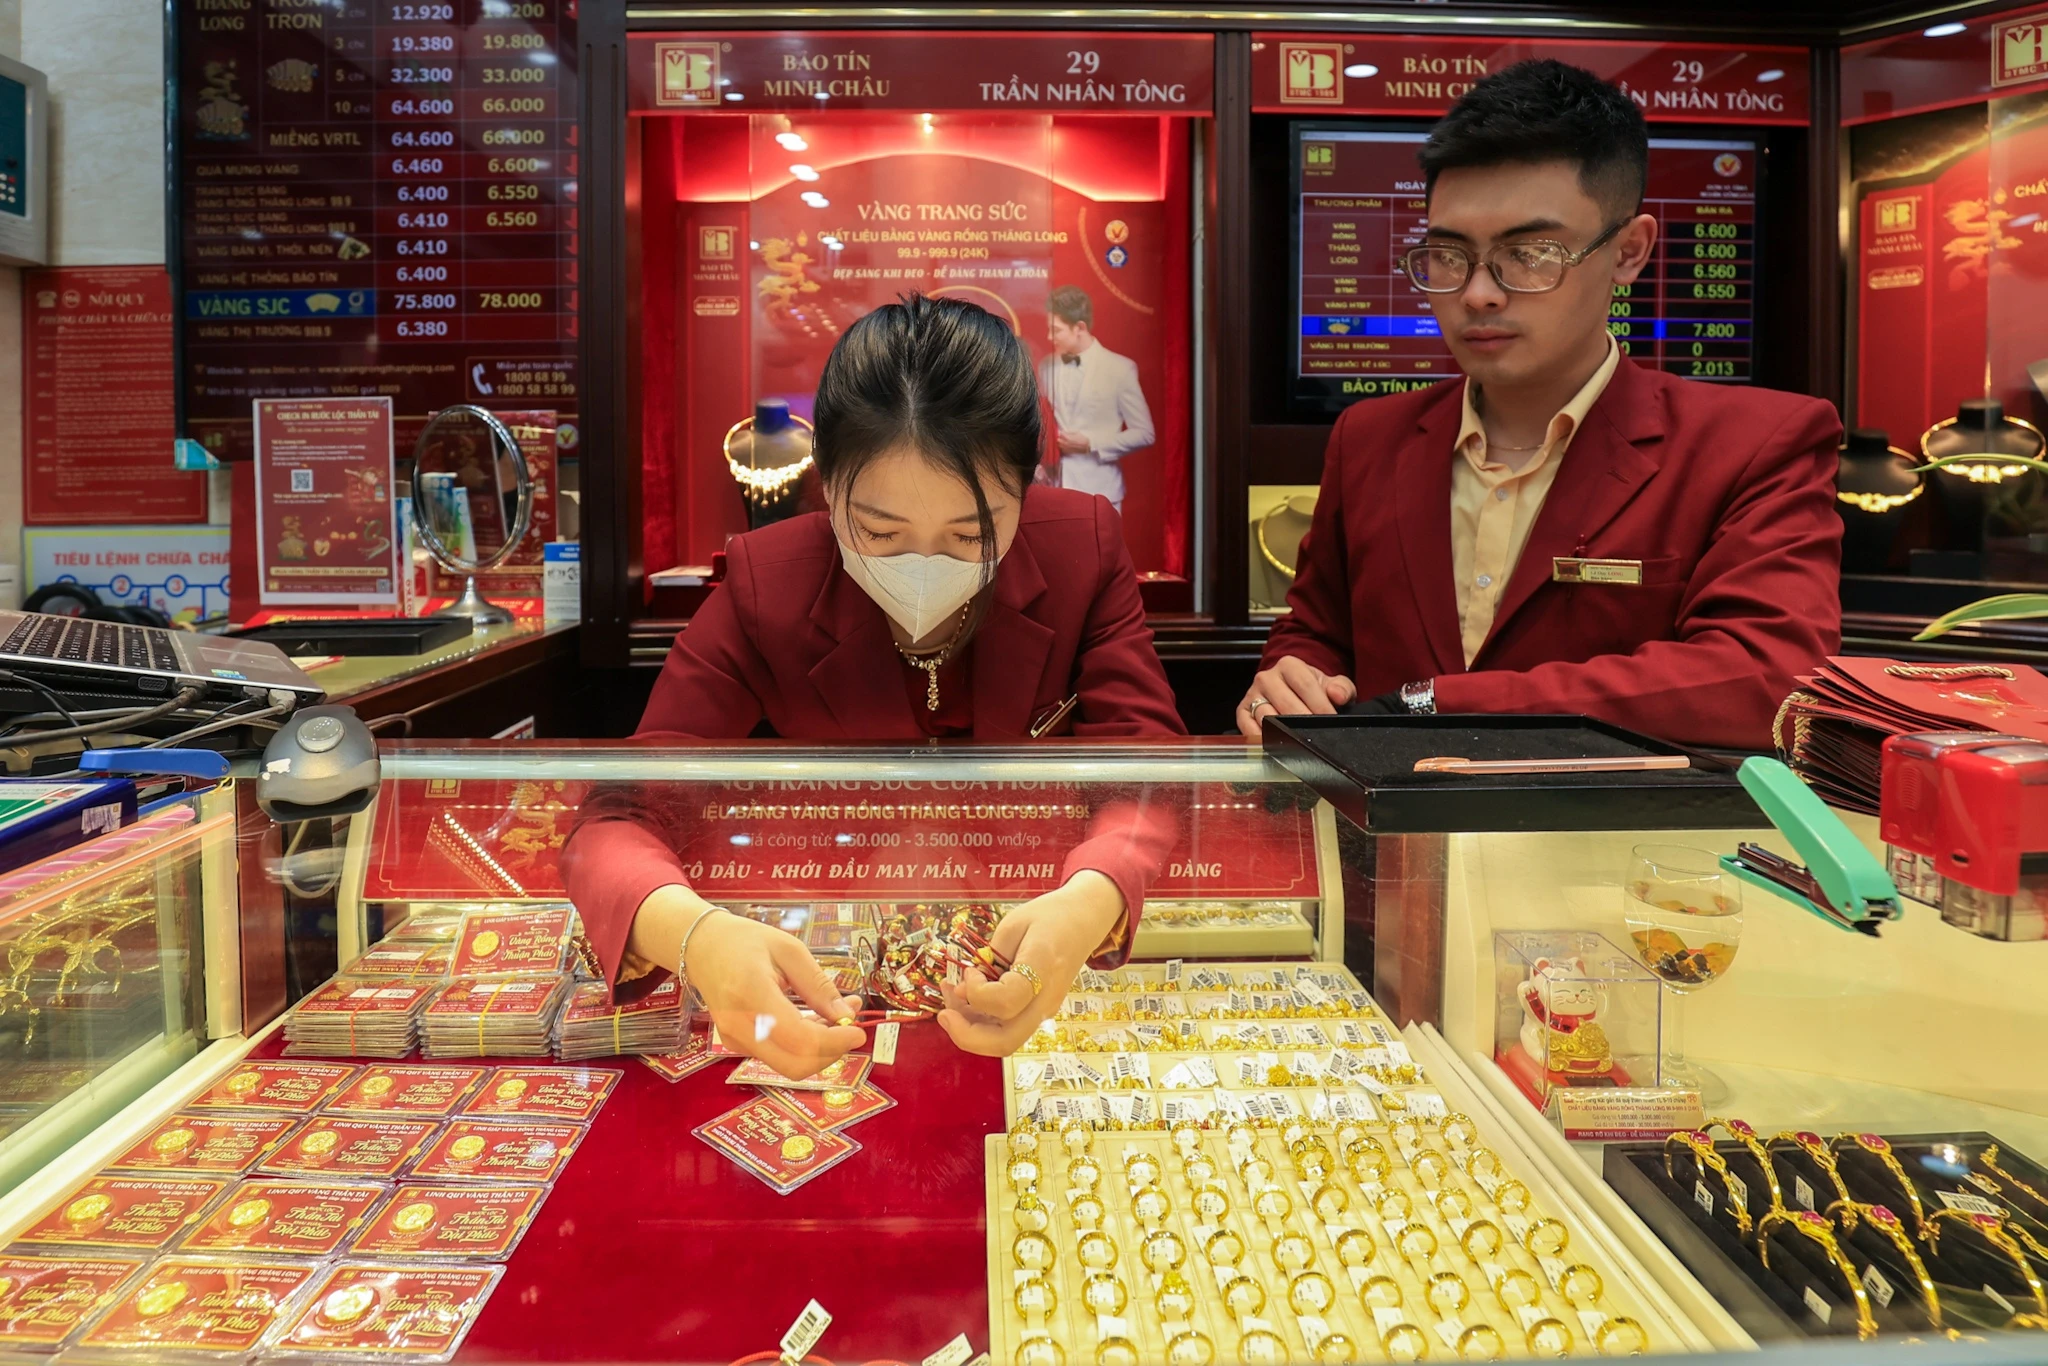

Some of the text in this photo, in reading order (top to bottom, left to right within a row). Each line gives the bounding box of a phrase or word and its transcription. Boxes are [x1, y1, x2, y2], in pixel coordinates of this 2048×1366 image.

[201, 16, 245, 31] LONG
[336, 7, 344, 18] 2
[392, 4, 544, 20] 12.920 1.200
[335, 34, 544, 52] 3 19.380 19.800
[783, 50, 871, 71] BẢO TÍN
[1066, 51, 1100, 74] 29
[1403, 53, 1488, 75] BẢO TÍN
[335, 67, 545, 83] 5 32.300 33.000
[1672, 60, 1704, 83] 29
[2005, 65, 2037, 78] BTMC
[764, 76, 890, 97] MINH CHÂU
[978, 74, 1186, 102] TRẦN NHÂN TÔNG
[1385, 81, 1476, 98] MINH CH
[334, 98, 545, 115] 10 64.600 66.000
[1654, 86, 1718, 109] NHÂN
[1725, 88, 1784, 112] TÔNG
[323, 132, 361, 146] VRTL
[391, 130, 453, 147] 64.600
[482, 129, 545, 145] 66.000
[391, 157, 538, 174] 6.460 6.600
[397, 184, 538, 201] 6.400 6.550
[2013, 178, 2048, 198] CHẤ
[858, 200, 1028, 221] VÀNG TRANG SỨC
[397, 211, 538, 228] 6.410 6.560
[852, 228, 878, 244] LIỆU
[881, 229, 915, 243] BẰNG
[918, 229, 952, 243] VÀNG
[992, 229, 1032, 243] THĂNG
[1035, 231, 1068, 244] LONG
[1694, 223, 1737, 239] 6.600
[396, 240, 448, 256] 6.410
[897, 247, 989, 260] 99.9 999.9 (24K)
[1694, 243, 1737, 259] 6.600
[1330, 255, 1358, 265] LONG
[396, 266, 447, 282] 6.400
[855, 268, 880, 279] SANG
[882, 268, 901, 279] KHI
[979, 268, 1013, 279] THANH
[1693, 263, 1737, 279] 6.560
[1693, 283, 1736, 299] 6.550
[198, 293, 542, 316] VÀNG SJC 75.800 78.000
[396, 321, 448, 337] 6.380
[1693, 323, 1735, 338] 7.800
[1692, 342, 1703, 357] 0
[1692, 361, 1734, 376] 2.013
[505, 372, 531, 382] 1800
[496, 384, 575, 395] 1800 58 58 99
[1342, 378, 1407, 393] BẢO TÍN
[116, 578, 182, 591] 2 3
[702, 799, 1090, 822] IỆU BẰNG VÀNG RỒNG THĂNG LONG 99.9 999
[768, 832, 808, 850] công
[811, 832, 832, 847] từ:
[914, 832, 993, 847] 3.500.000
[997, 832, 1041, 850] vnđ/sp
[709, 861, 751, 879] DÂU
[771, 859, 823, 879] KHỞI
[828, 857, 869, 879] ĐẦU
[875, 863, 918, 879] MAY
[922, 857, 967, 879] MẮN
[988, 863, 1055, 879] THANH
[1169, 859, 1222, 879] DÀNG
